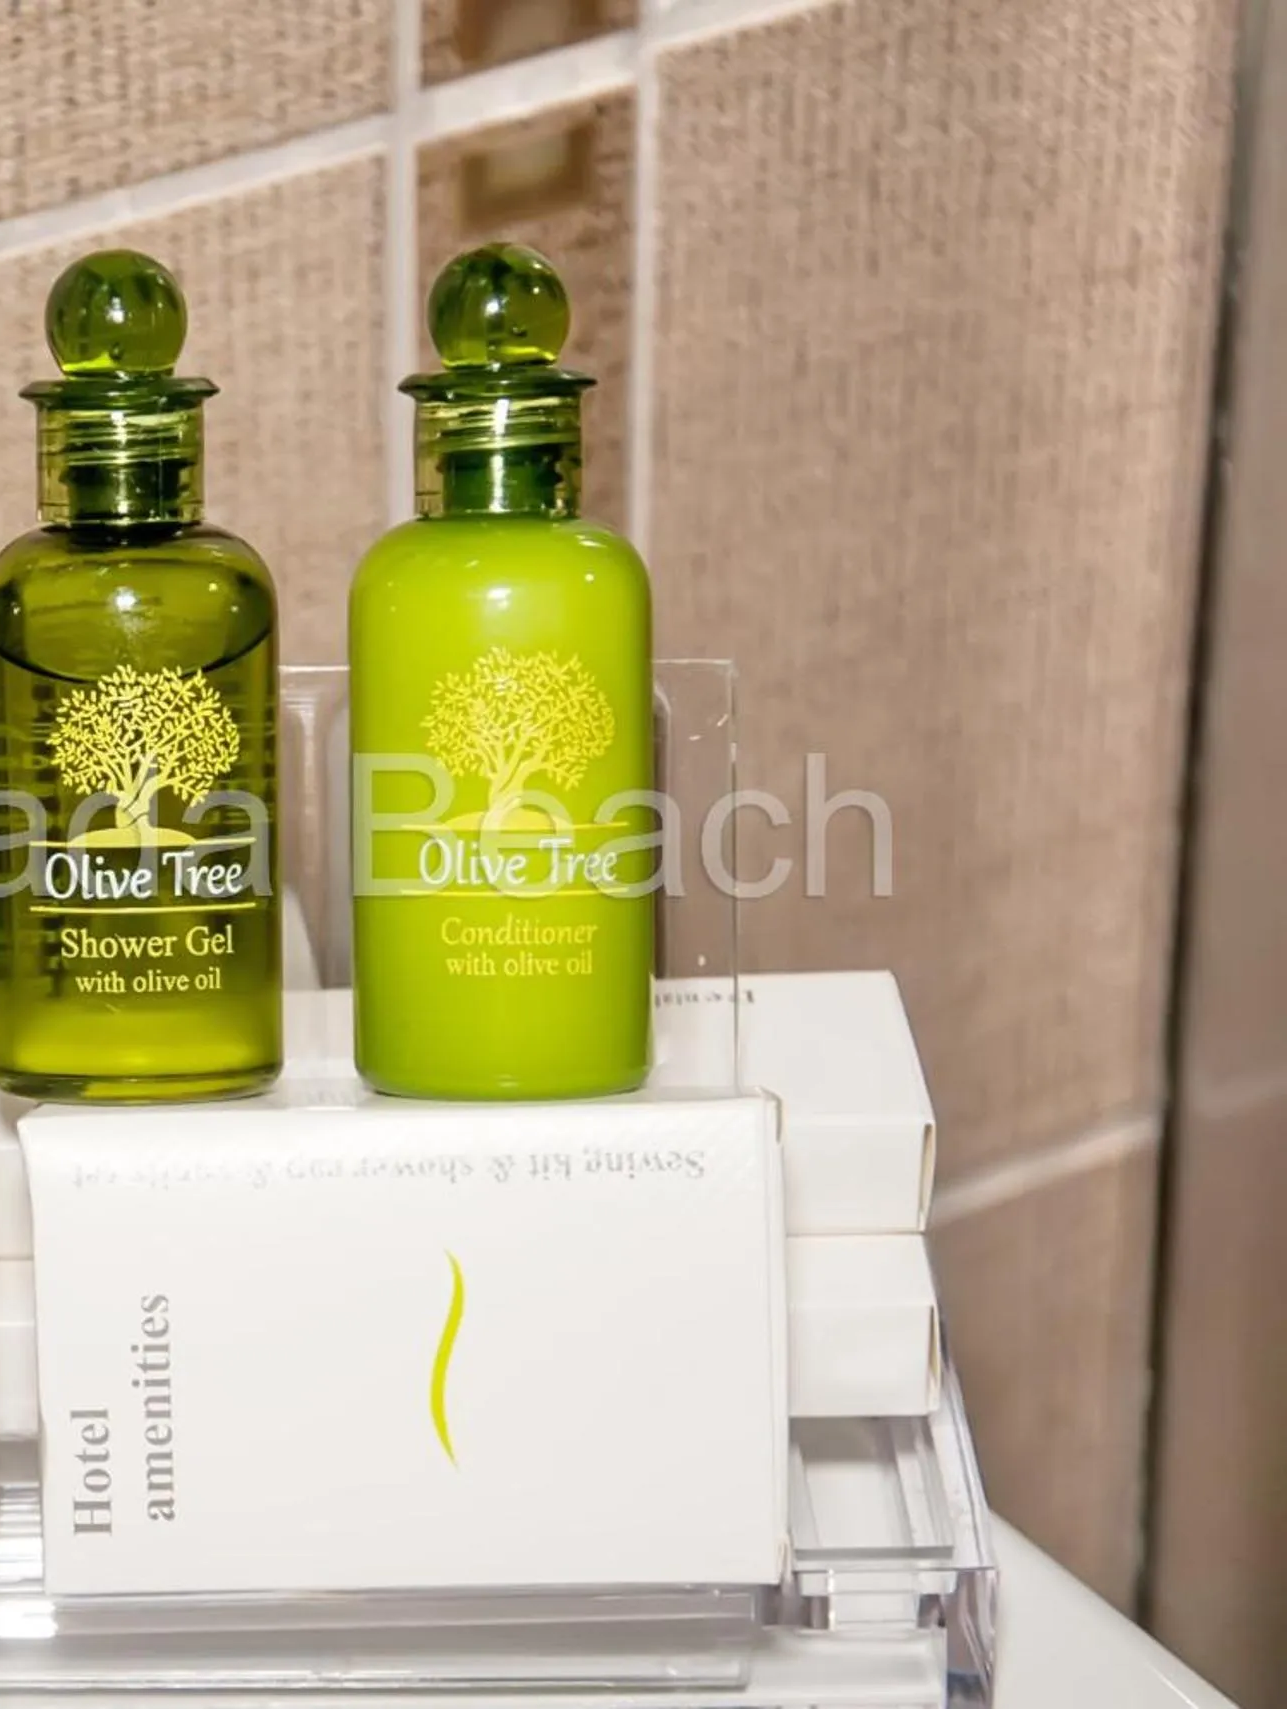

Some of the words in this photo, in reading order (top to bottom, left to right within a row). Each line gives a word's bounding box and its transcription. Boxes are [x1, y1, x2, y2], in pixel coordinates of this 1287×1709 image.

[44, 852, 153, 900] Olive
[162, 850, 243, 896] Tree
[419, 837, 528, 886] Olive
[538, 837, 619, 884] Tree
[61, 928, 178, 959] Shower
[185, 923, 235, 957] Gel
[440, 912, 599, 946] Conditioner
[75, 970, 126, 994] with
[132, 969, 190, 993] olive
[194, 967, 222, 990] oil
[445, 952, 496, 976] with
[503, 951, 559, 977] olive
[566, 949, 593, 975] oil
[529, 1153, 572, 1181] kit
[582, 1147, 706, 1180] Sewing
[130, 1294, 176, 1522] amenities
[69, 1408, 113, 1535] Hotel
